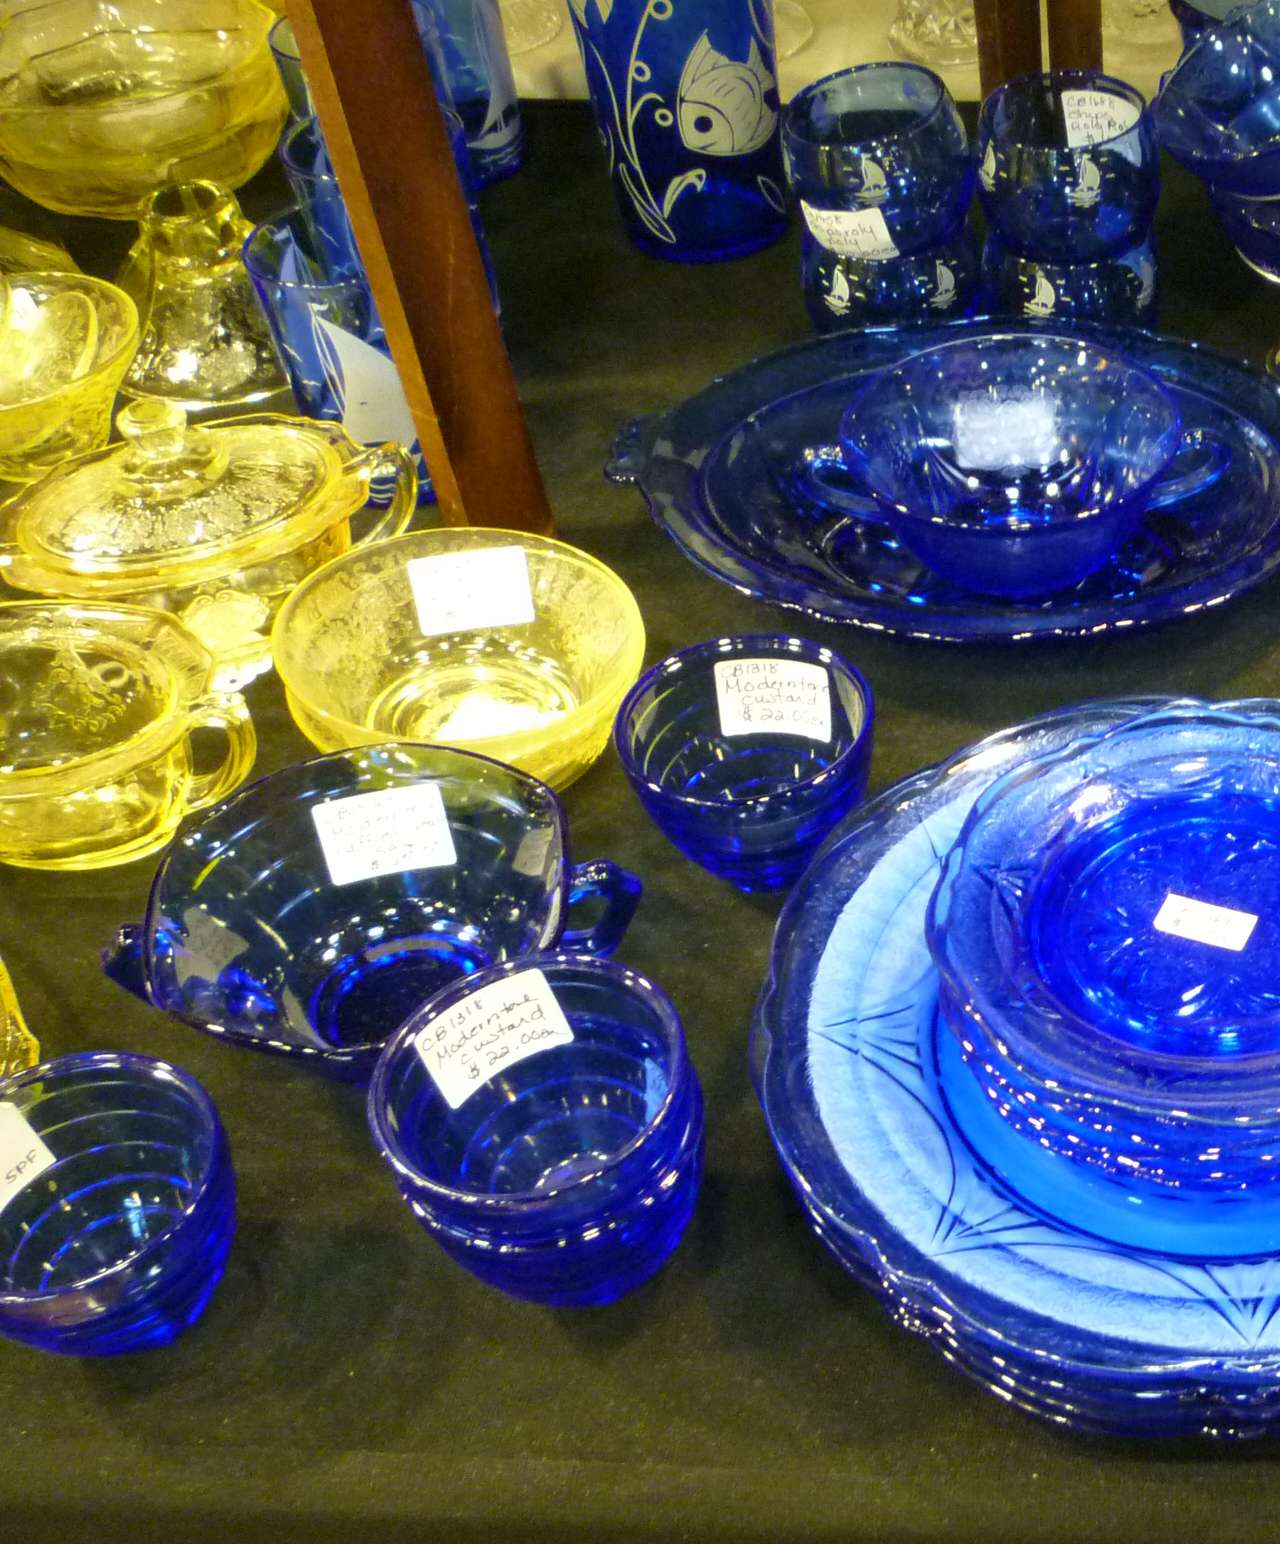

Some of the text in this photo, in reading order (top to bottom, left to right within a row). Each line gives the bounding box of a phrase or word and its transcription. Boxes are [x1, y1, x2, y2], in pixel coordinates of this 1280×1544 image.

[742, 688, 817, 706] custard
[422, 997, 484, 1051] CB1318
[460, 1003, 546, 1065] custard
[4, 1148, 37, 1184] SPF
